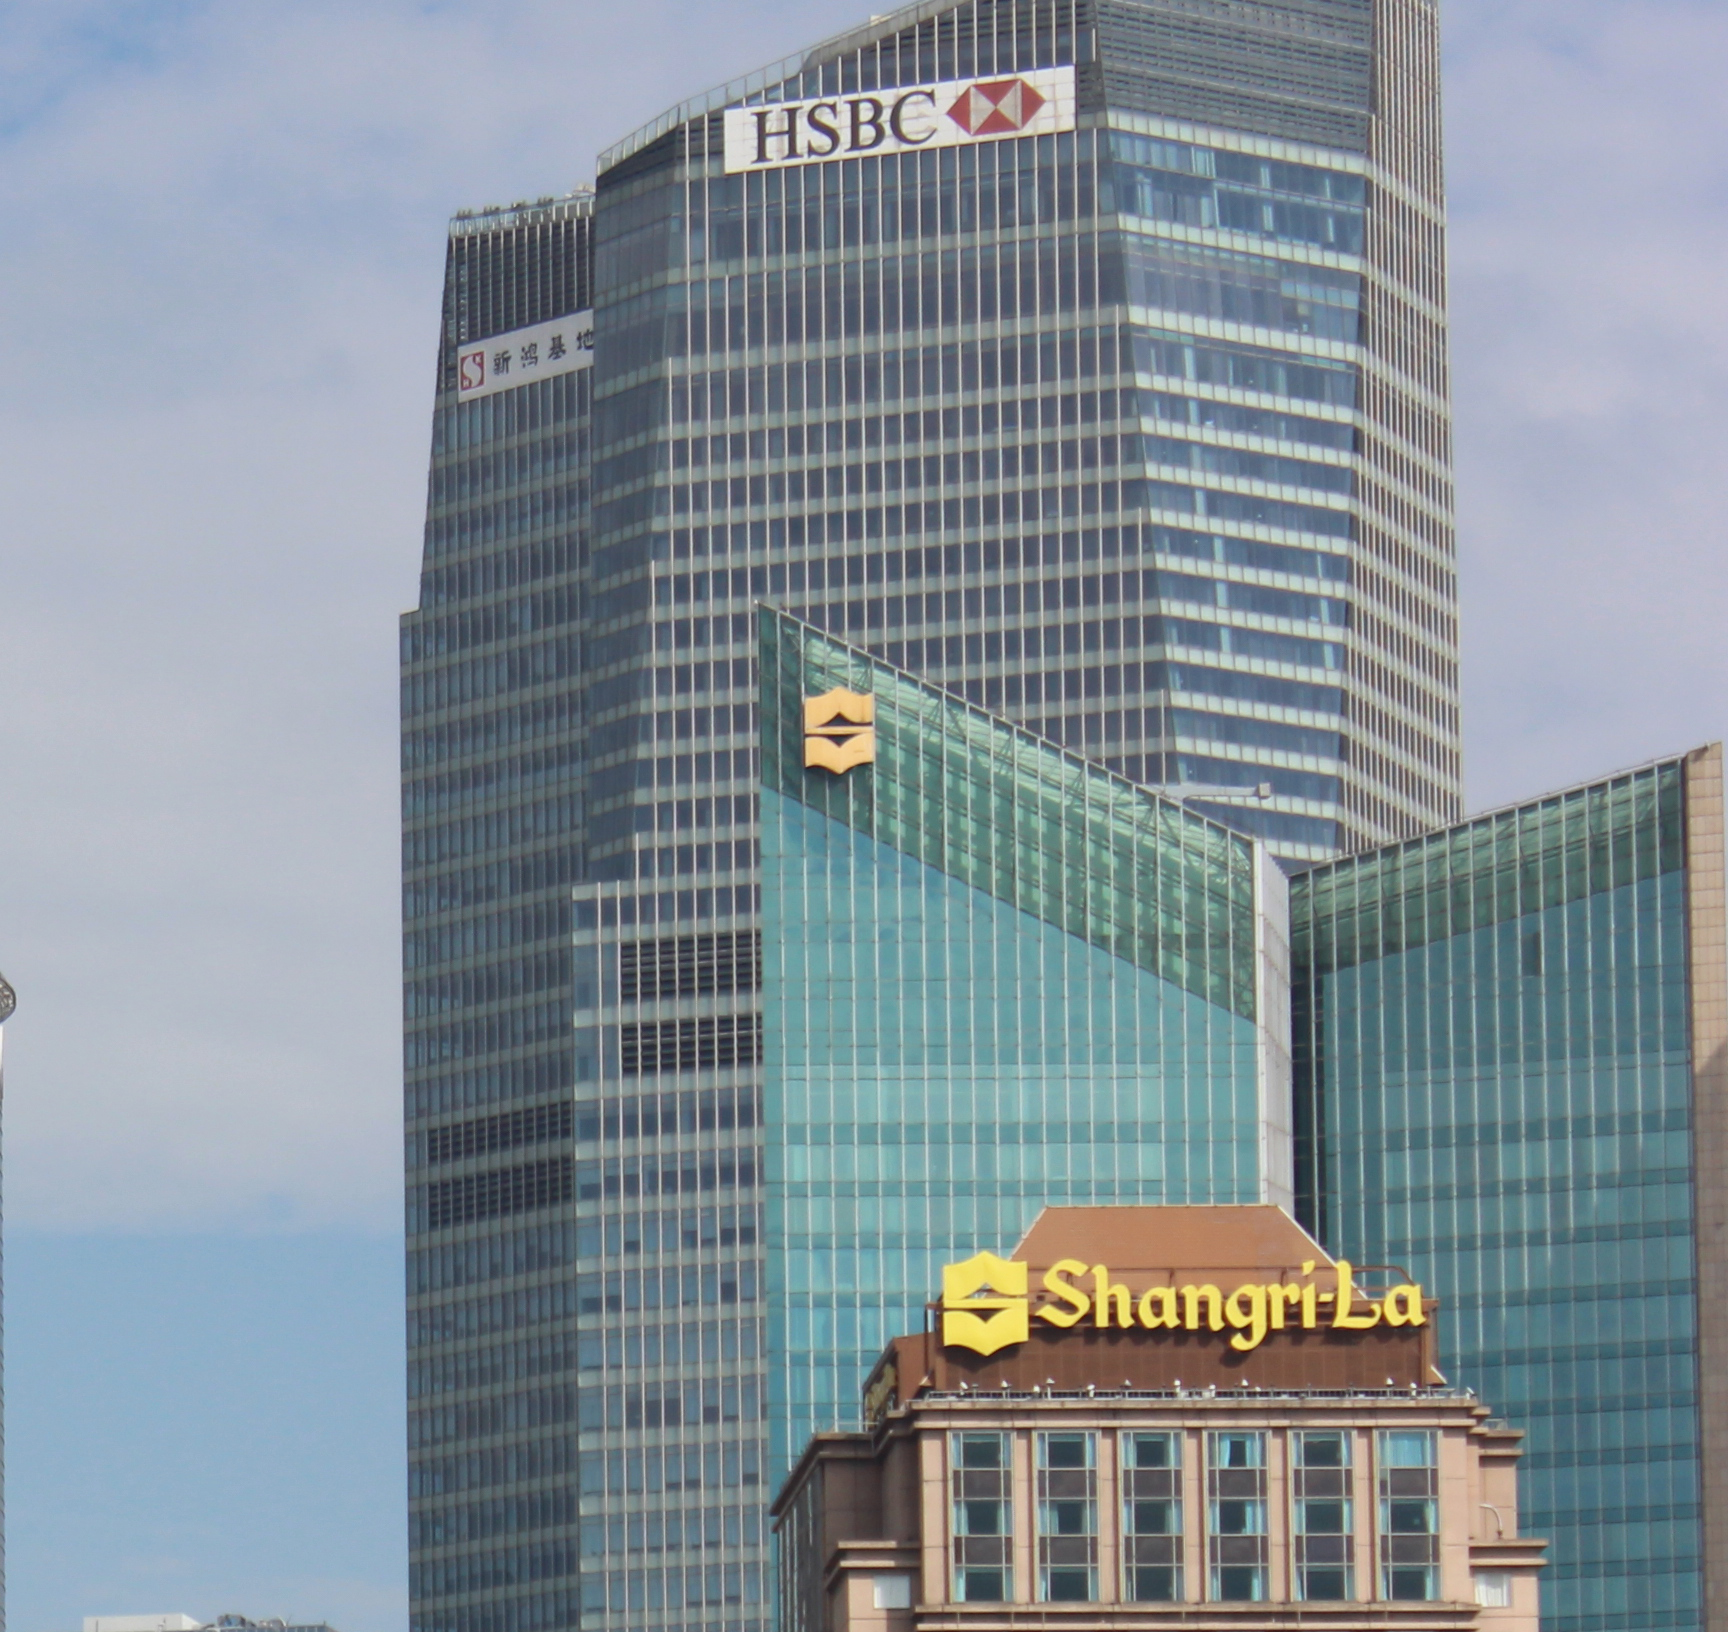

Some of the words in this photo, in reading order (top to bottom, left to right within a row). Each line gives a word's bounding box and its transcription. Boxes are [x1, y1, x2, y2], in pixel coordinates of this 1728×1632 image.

[750, 88, 937, 164] HSBC
[493, 329, 593, 376] 新鸿基地
[1034, 1258, 1426, 1351] Shangri-La
